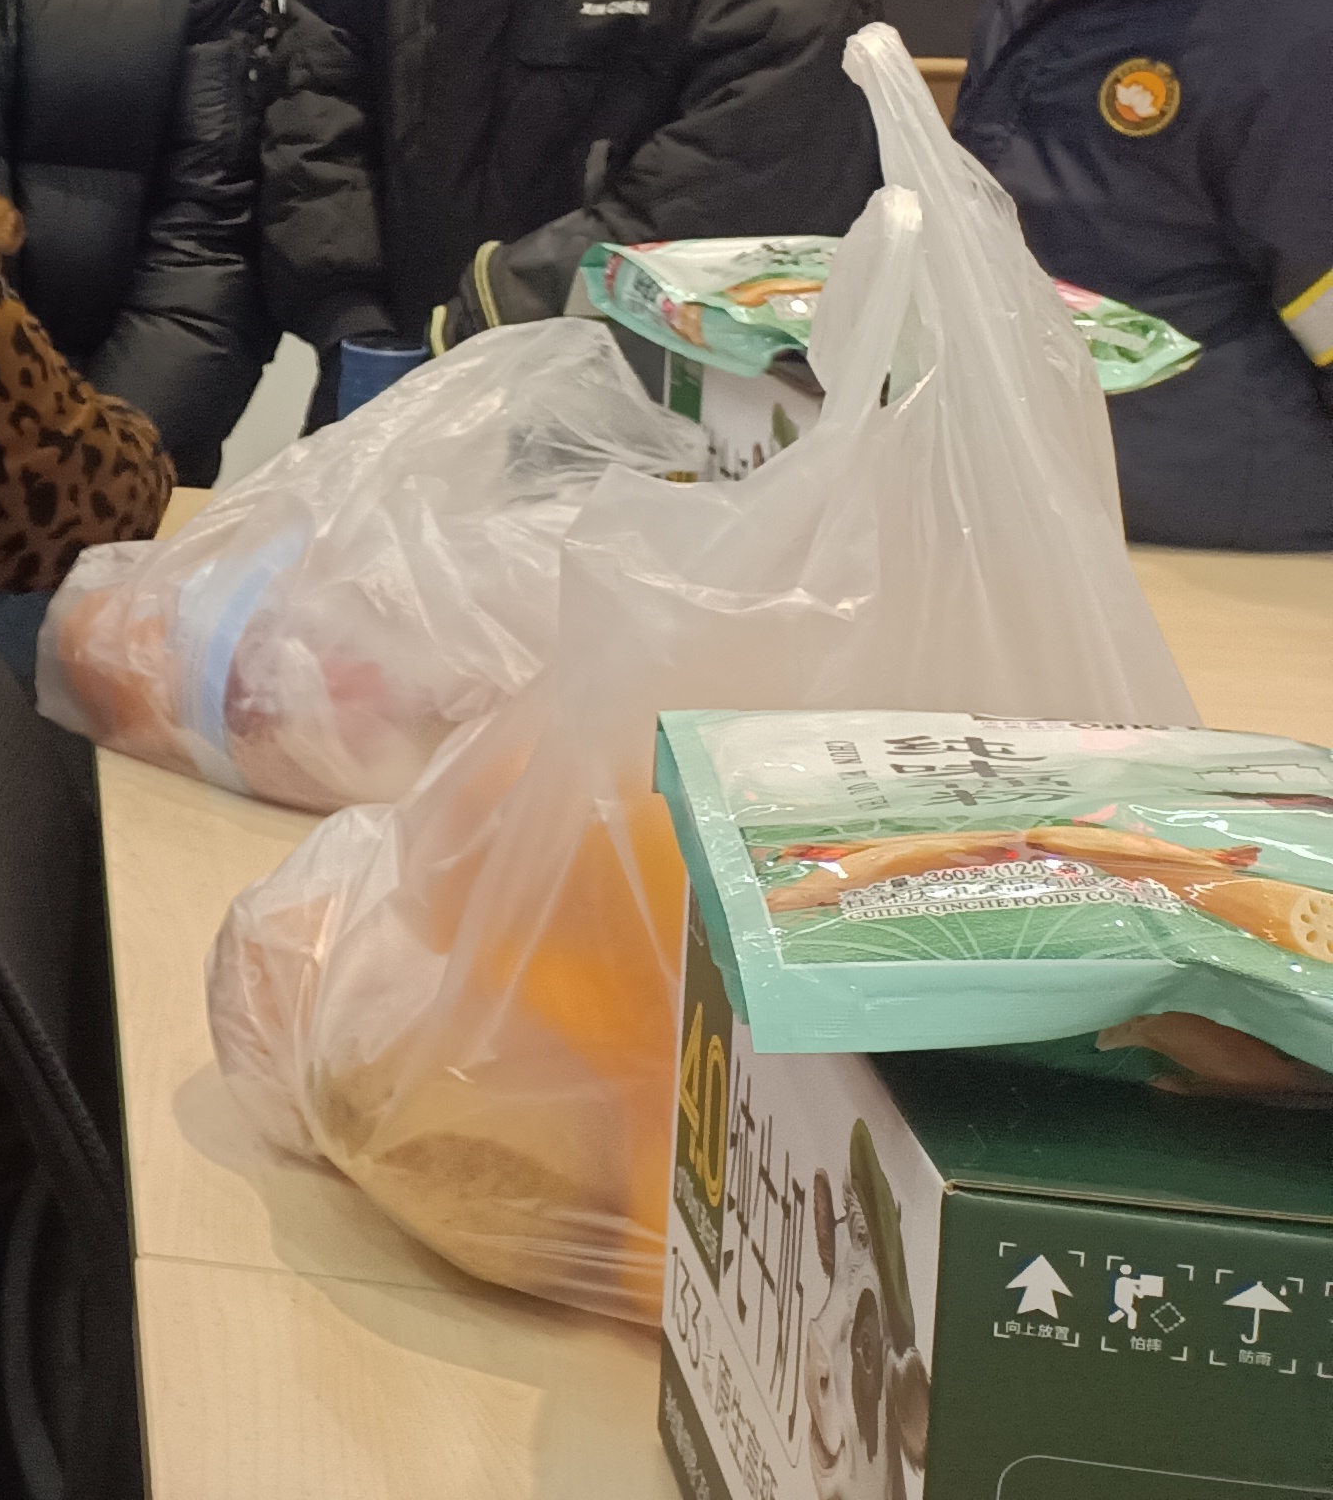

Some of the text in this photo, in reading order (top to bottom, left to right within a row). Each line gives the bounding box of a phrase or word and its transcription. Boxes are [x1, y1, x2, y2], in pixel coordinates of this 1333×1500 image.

[848, 904, 920, 921] GUILIN
[925, 897, 1008, 915] QINGHE
[1014, 892, 1081, 907] FOODS
[723, 1056, 806, 1443] 纯牛奶
[1005, 1320, 1070, 1341] 向上放置
[1238, 1350, 1272, 1367] 防雨
